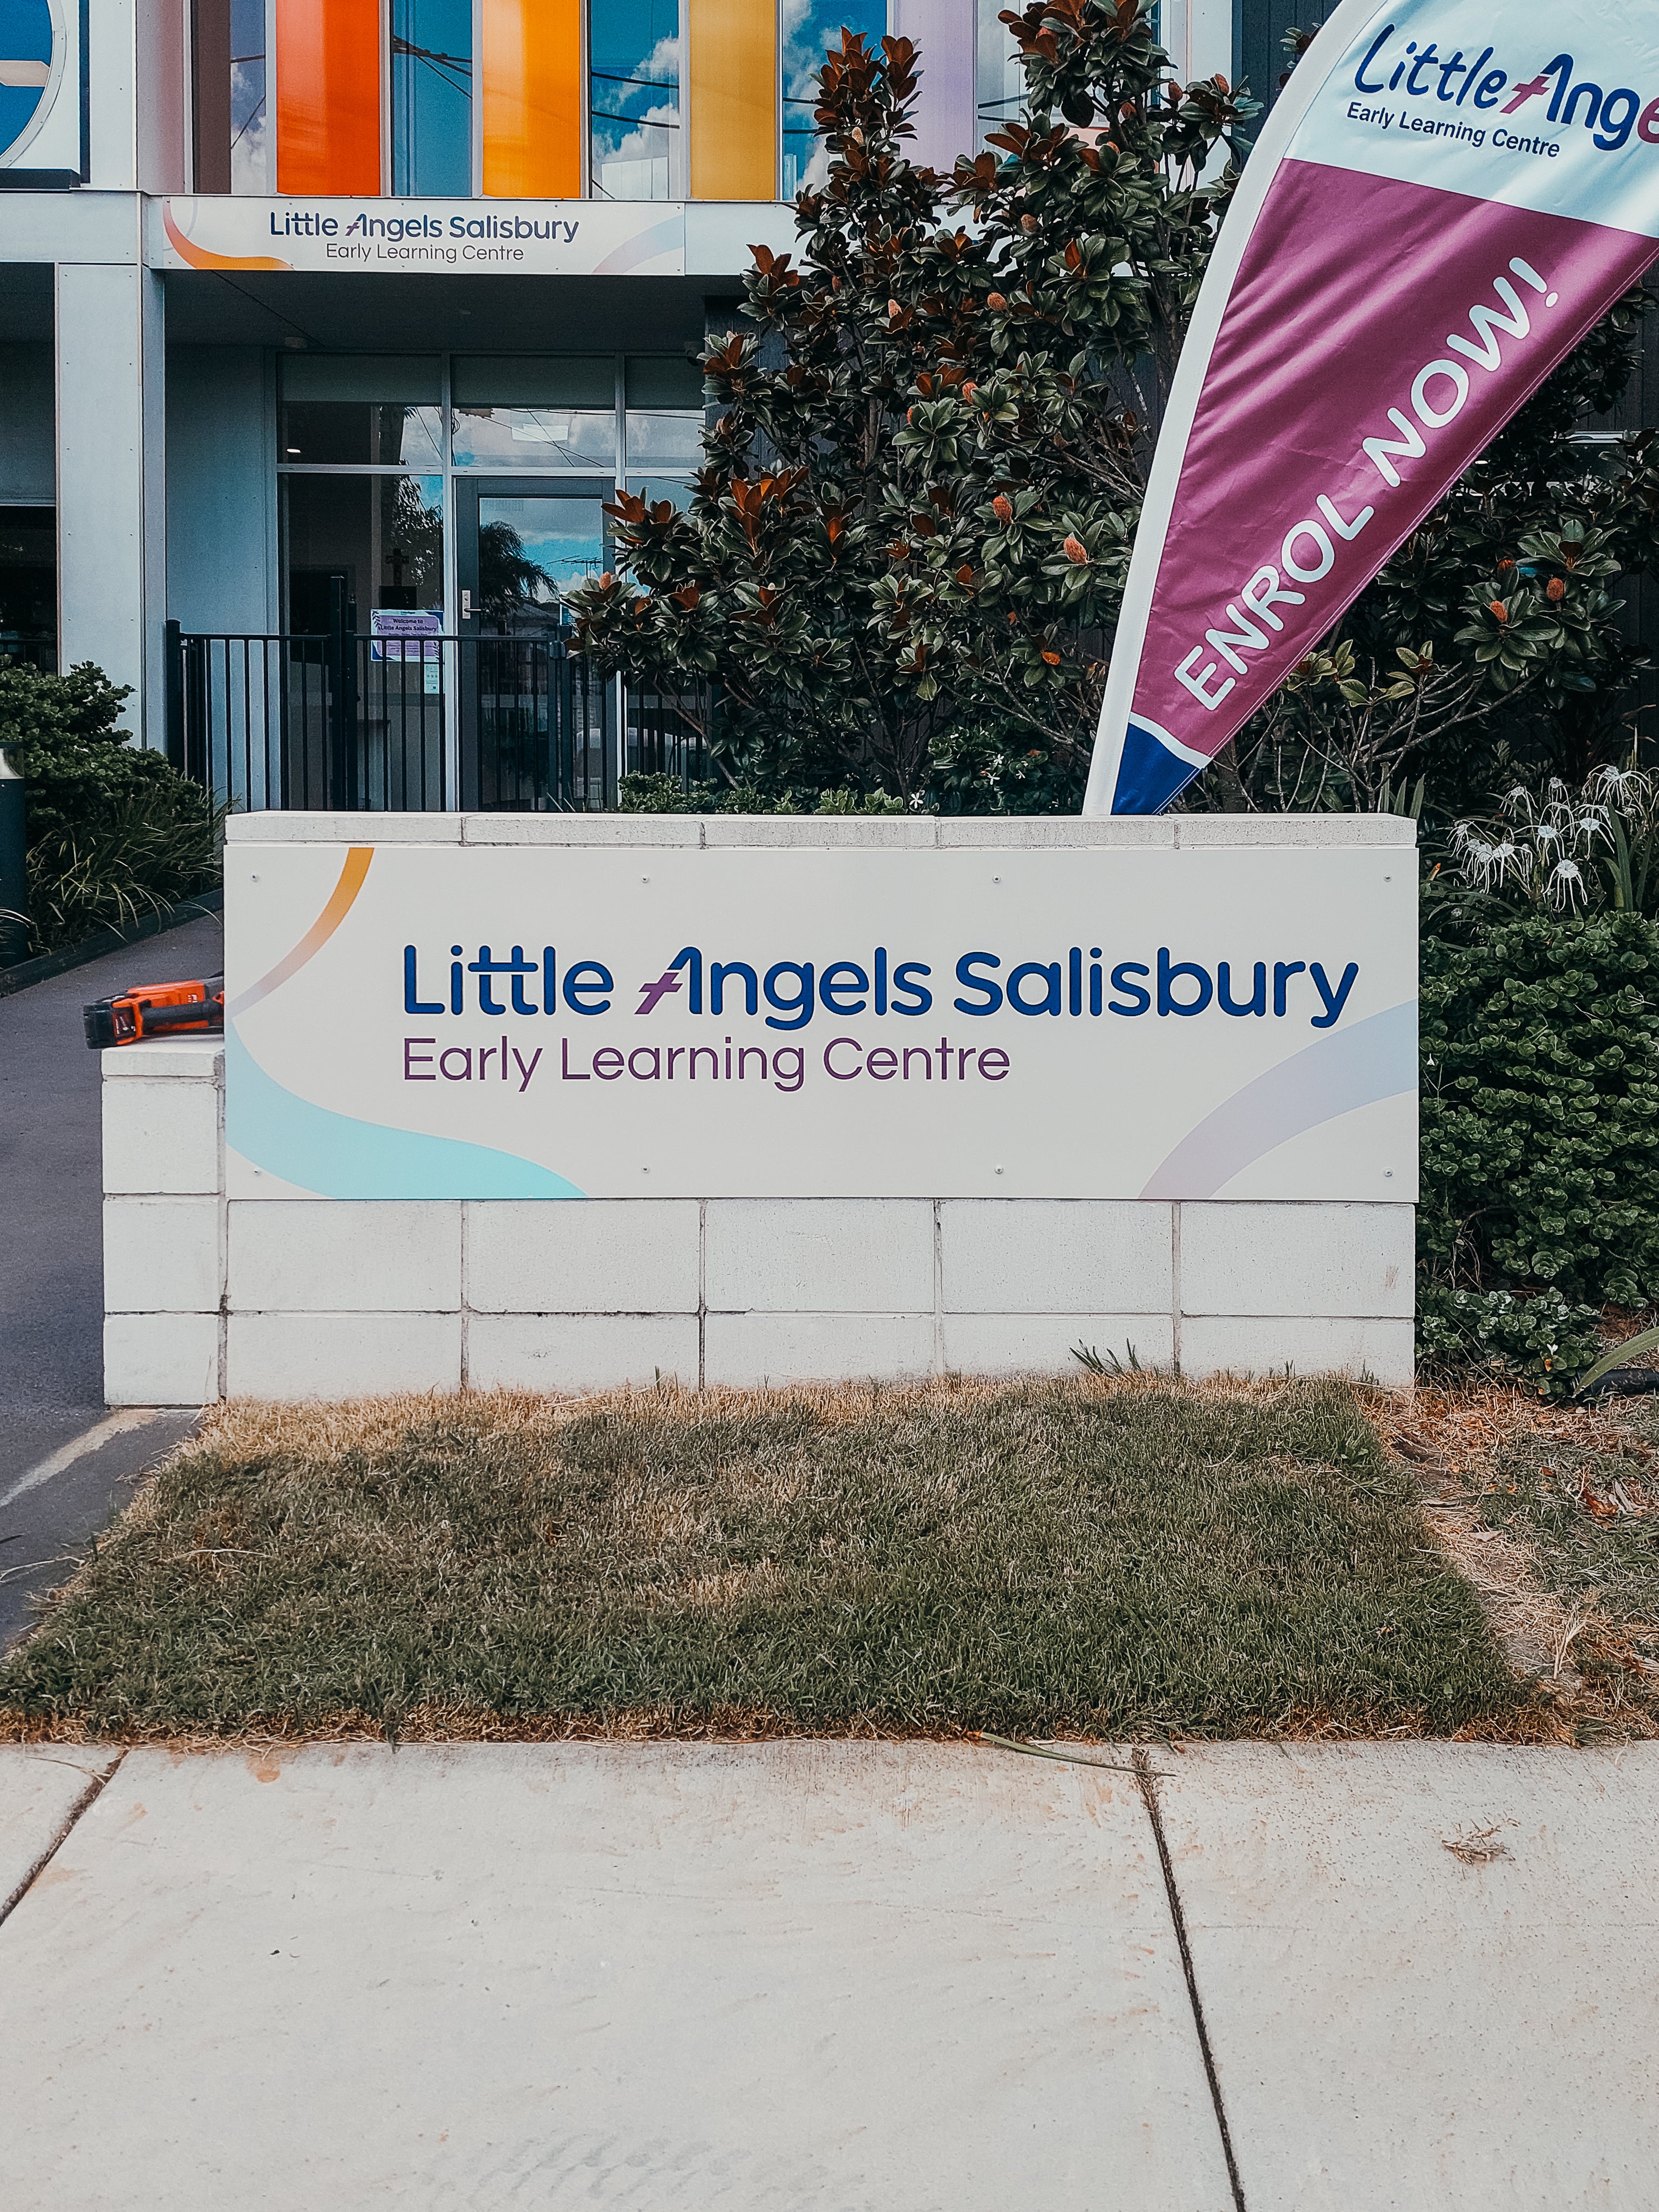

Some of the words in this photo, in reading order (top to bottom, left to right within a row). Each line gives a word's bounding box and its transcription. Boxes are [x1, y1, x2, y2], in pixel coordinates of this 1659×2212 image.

[1354, 23, 1508, 110] Little
[1347, 101, 1395, 130] Early
[1399, 111, 1486, 148] Learning
[1492, 128, 1560, 158] Centre
[270, 212, 338, 236] Little
[345, 213, 443, 242] Angels
[449, 215, 580, 243] Salisbury
[327, 243, 371, 262] Early
[377, 244, 457, 263] Learning
[463, 245, 524, 261] Centre
[1174, 494, 1375, 711] ENROL
[1362, 256, 1559, 488] NOW!
[404, 944, 614, 1016] Little
[634, 946, 933, 1031] Angels
[953, 947, 1359, 1029] Salisbury
[404, 1036, 543, 1092] Early
[562, 1036, 804, 1092] Learning
[823, 1037, 1010, 1080] Centre
